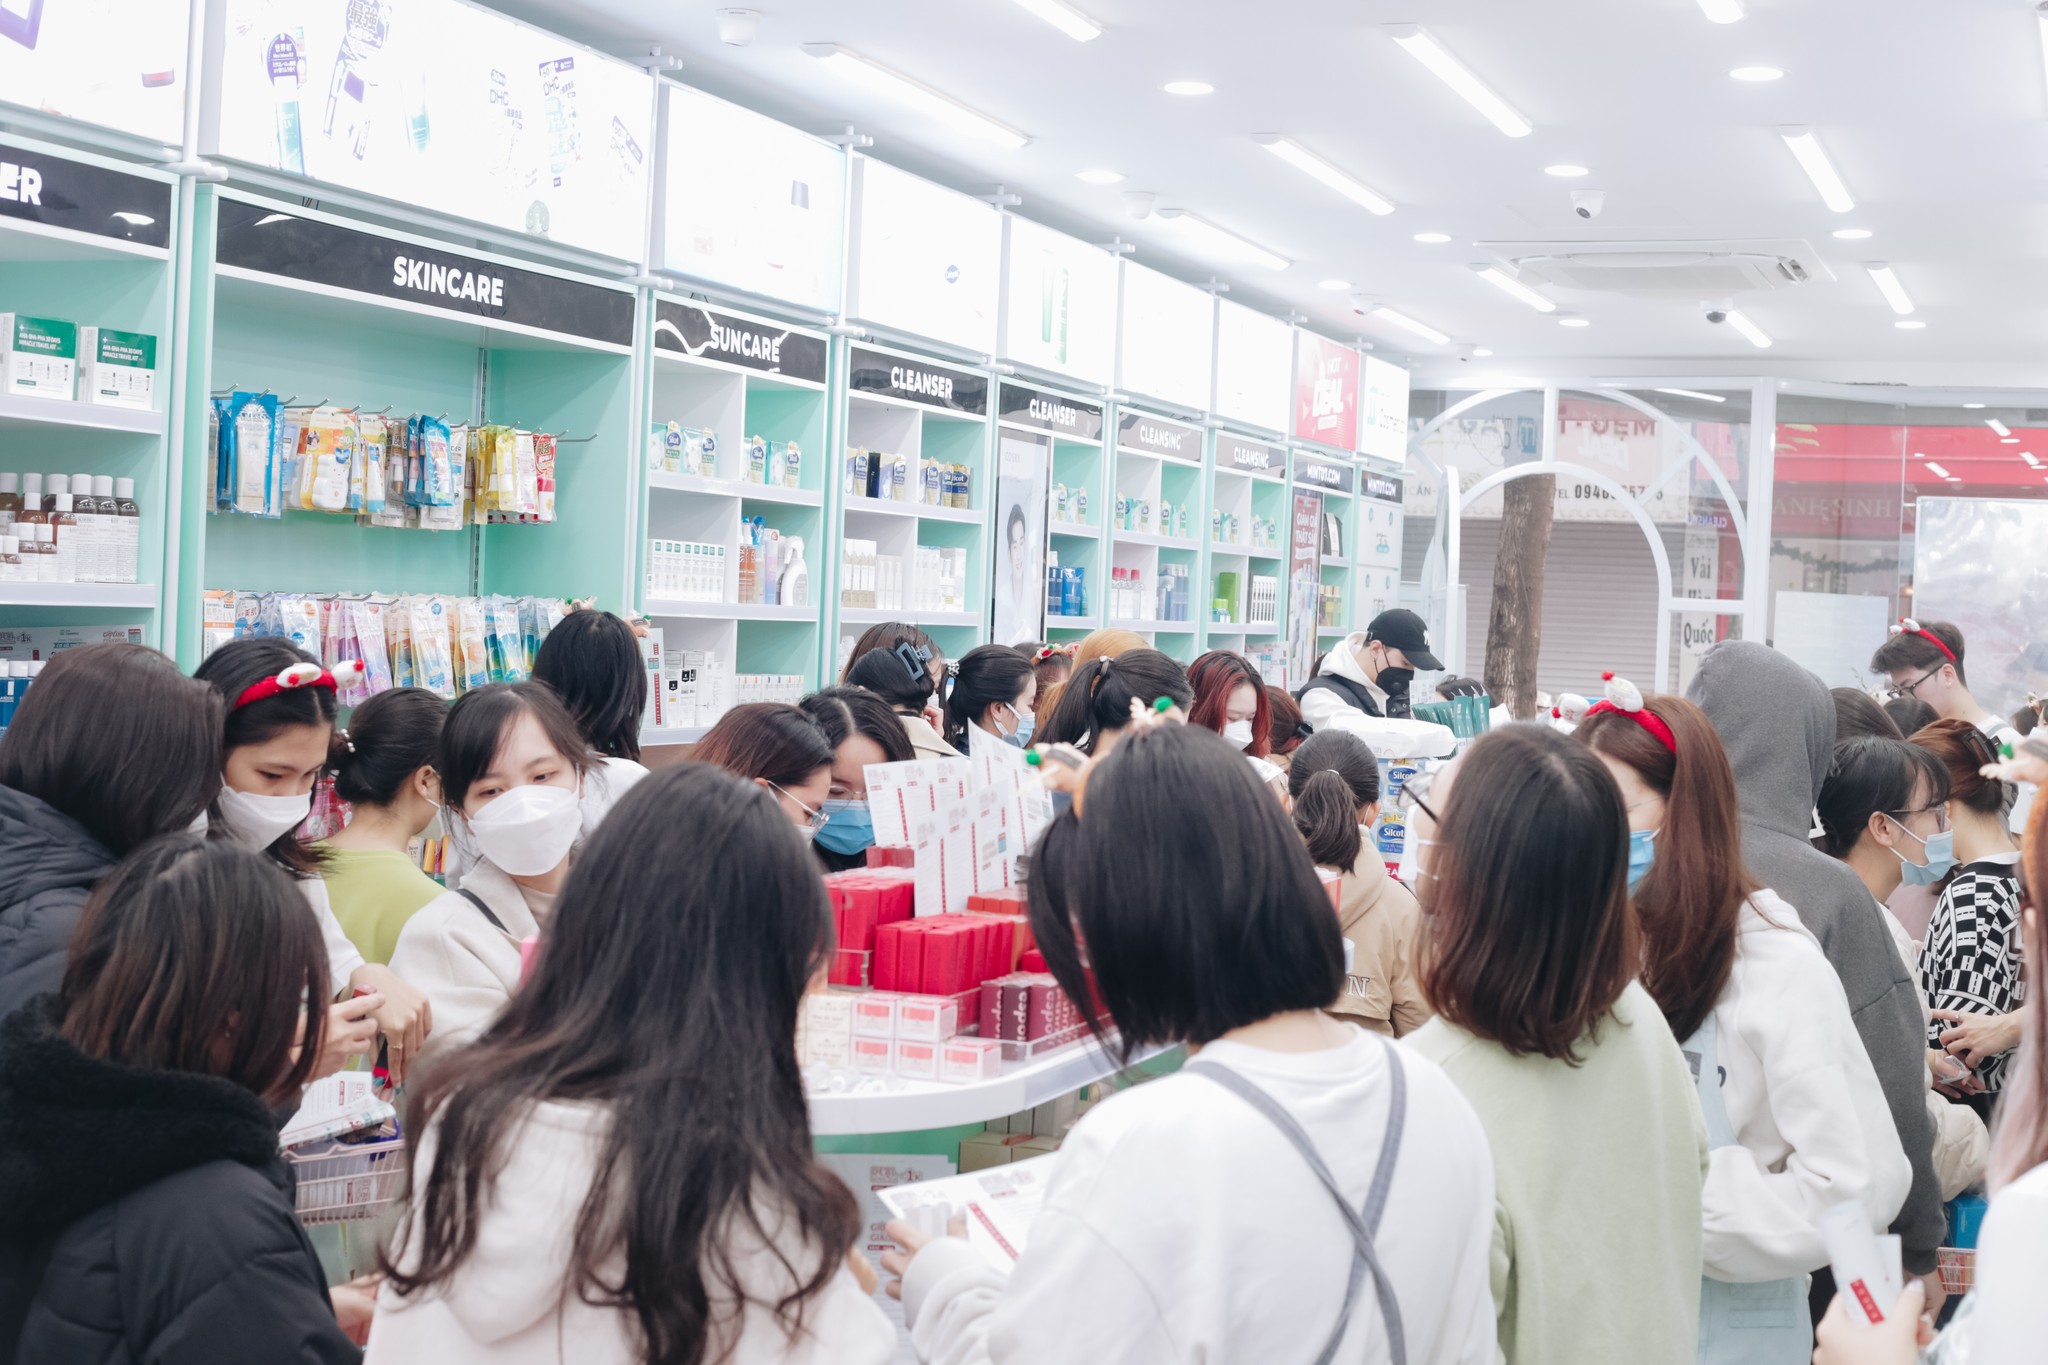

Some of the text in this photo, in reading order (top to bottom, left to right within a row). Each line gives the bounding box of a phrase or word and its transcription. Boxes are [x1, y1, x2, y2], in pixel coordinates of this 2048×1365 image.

[489, 88, 509, 106] DHC
[543, 76, 560, 96] DHC
[393, 255, 504, 307] SKINCARE
[710, 325, 780, 364] SUNCARE
[891, 366, 953, 400] CLEANSER
[1029, 398, 1077, 428] CLEANSER
[1140, 425, 1182, 450] CLEANSING
[1234, 446, 1269, 469] CLEANSING
[1683, 618, 1713, 648] Quốc
[1384, 827, 1405, 838] Silcot
